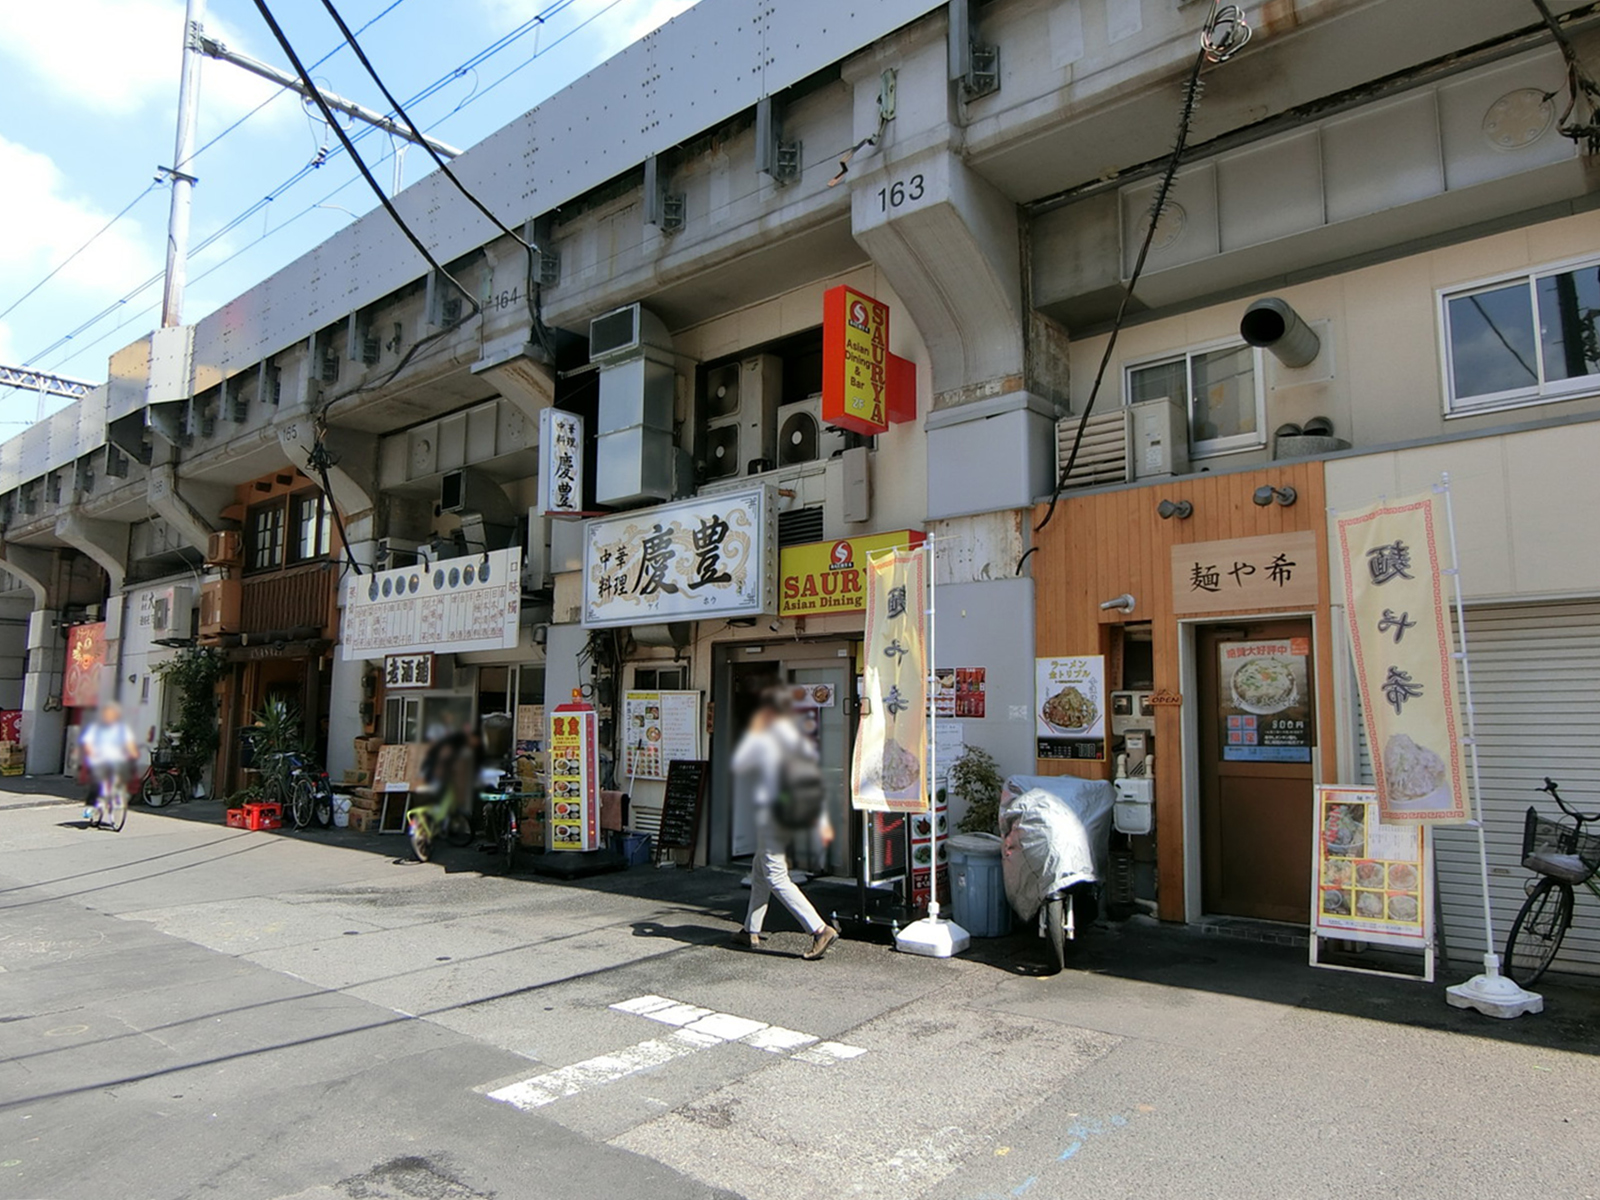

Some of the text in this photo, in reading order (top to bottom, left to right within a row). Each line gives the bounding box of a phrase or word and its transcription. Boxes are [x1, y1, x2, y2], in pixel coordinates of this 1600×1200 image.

[878, 174, 924, 212] 163
[495, 286, 518, 312] 164
[846, 339, 870, 356] Asian
[845, 350, 871, 370] Dining
[871, 304, 885, 424] SAURYA
[854, 366, 861, 377] &
[850, 377, 865, 390] Bar
[852, 397, 865, 410] 2F
[557, 422, 576, 434] 中華
[557, 435, 576, 448] 料理
[555, 452, 574, 508] 慶豊
[600, 545, 628, 572] 中華
[631, 514, 732, 596] 慶豊
[1190, 553, 1297, 592] 麺や希
[598, 574, 628, 599] 料理
[784, 568, 866, 600] SAUR
[783, 595, 863, 611] Asian Dining
[1051, 660, 1087, 670] ラーメン
[1151, 696, 1179, 704] OPEN
